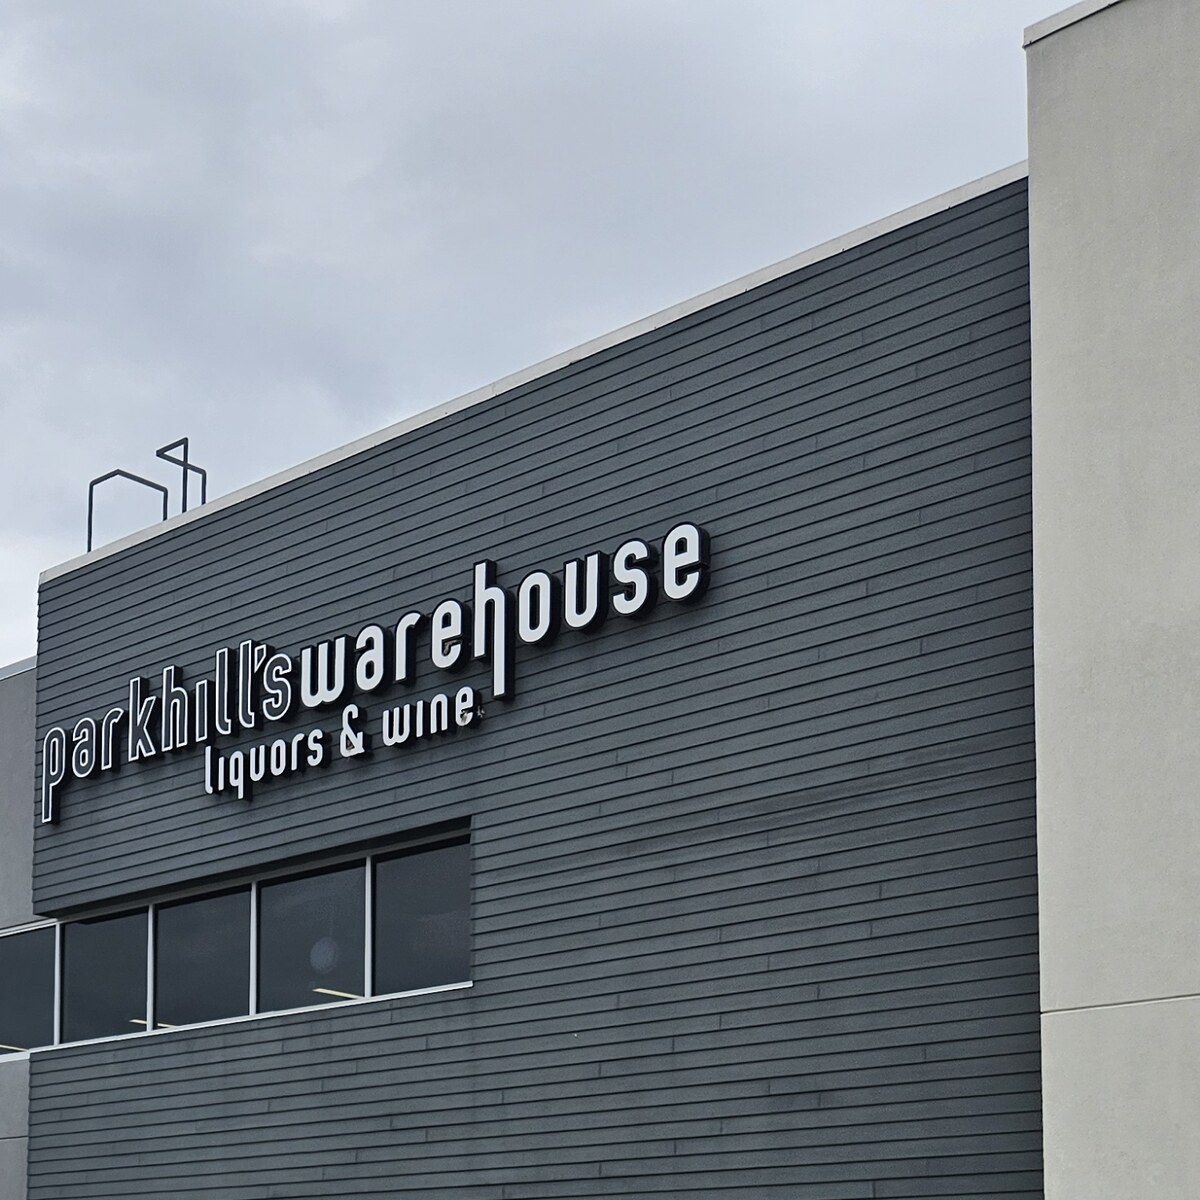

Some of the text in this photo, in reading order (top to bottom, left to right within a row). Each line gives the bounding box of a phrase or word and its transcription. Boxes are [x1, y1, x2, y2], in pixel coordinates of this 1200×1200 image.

[204, 686, 474, 800] liquors & wine
